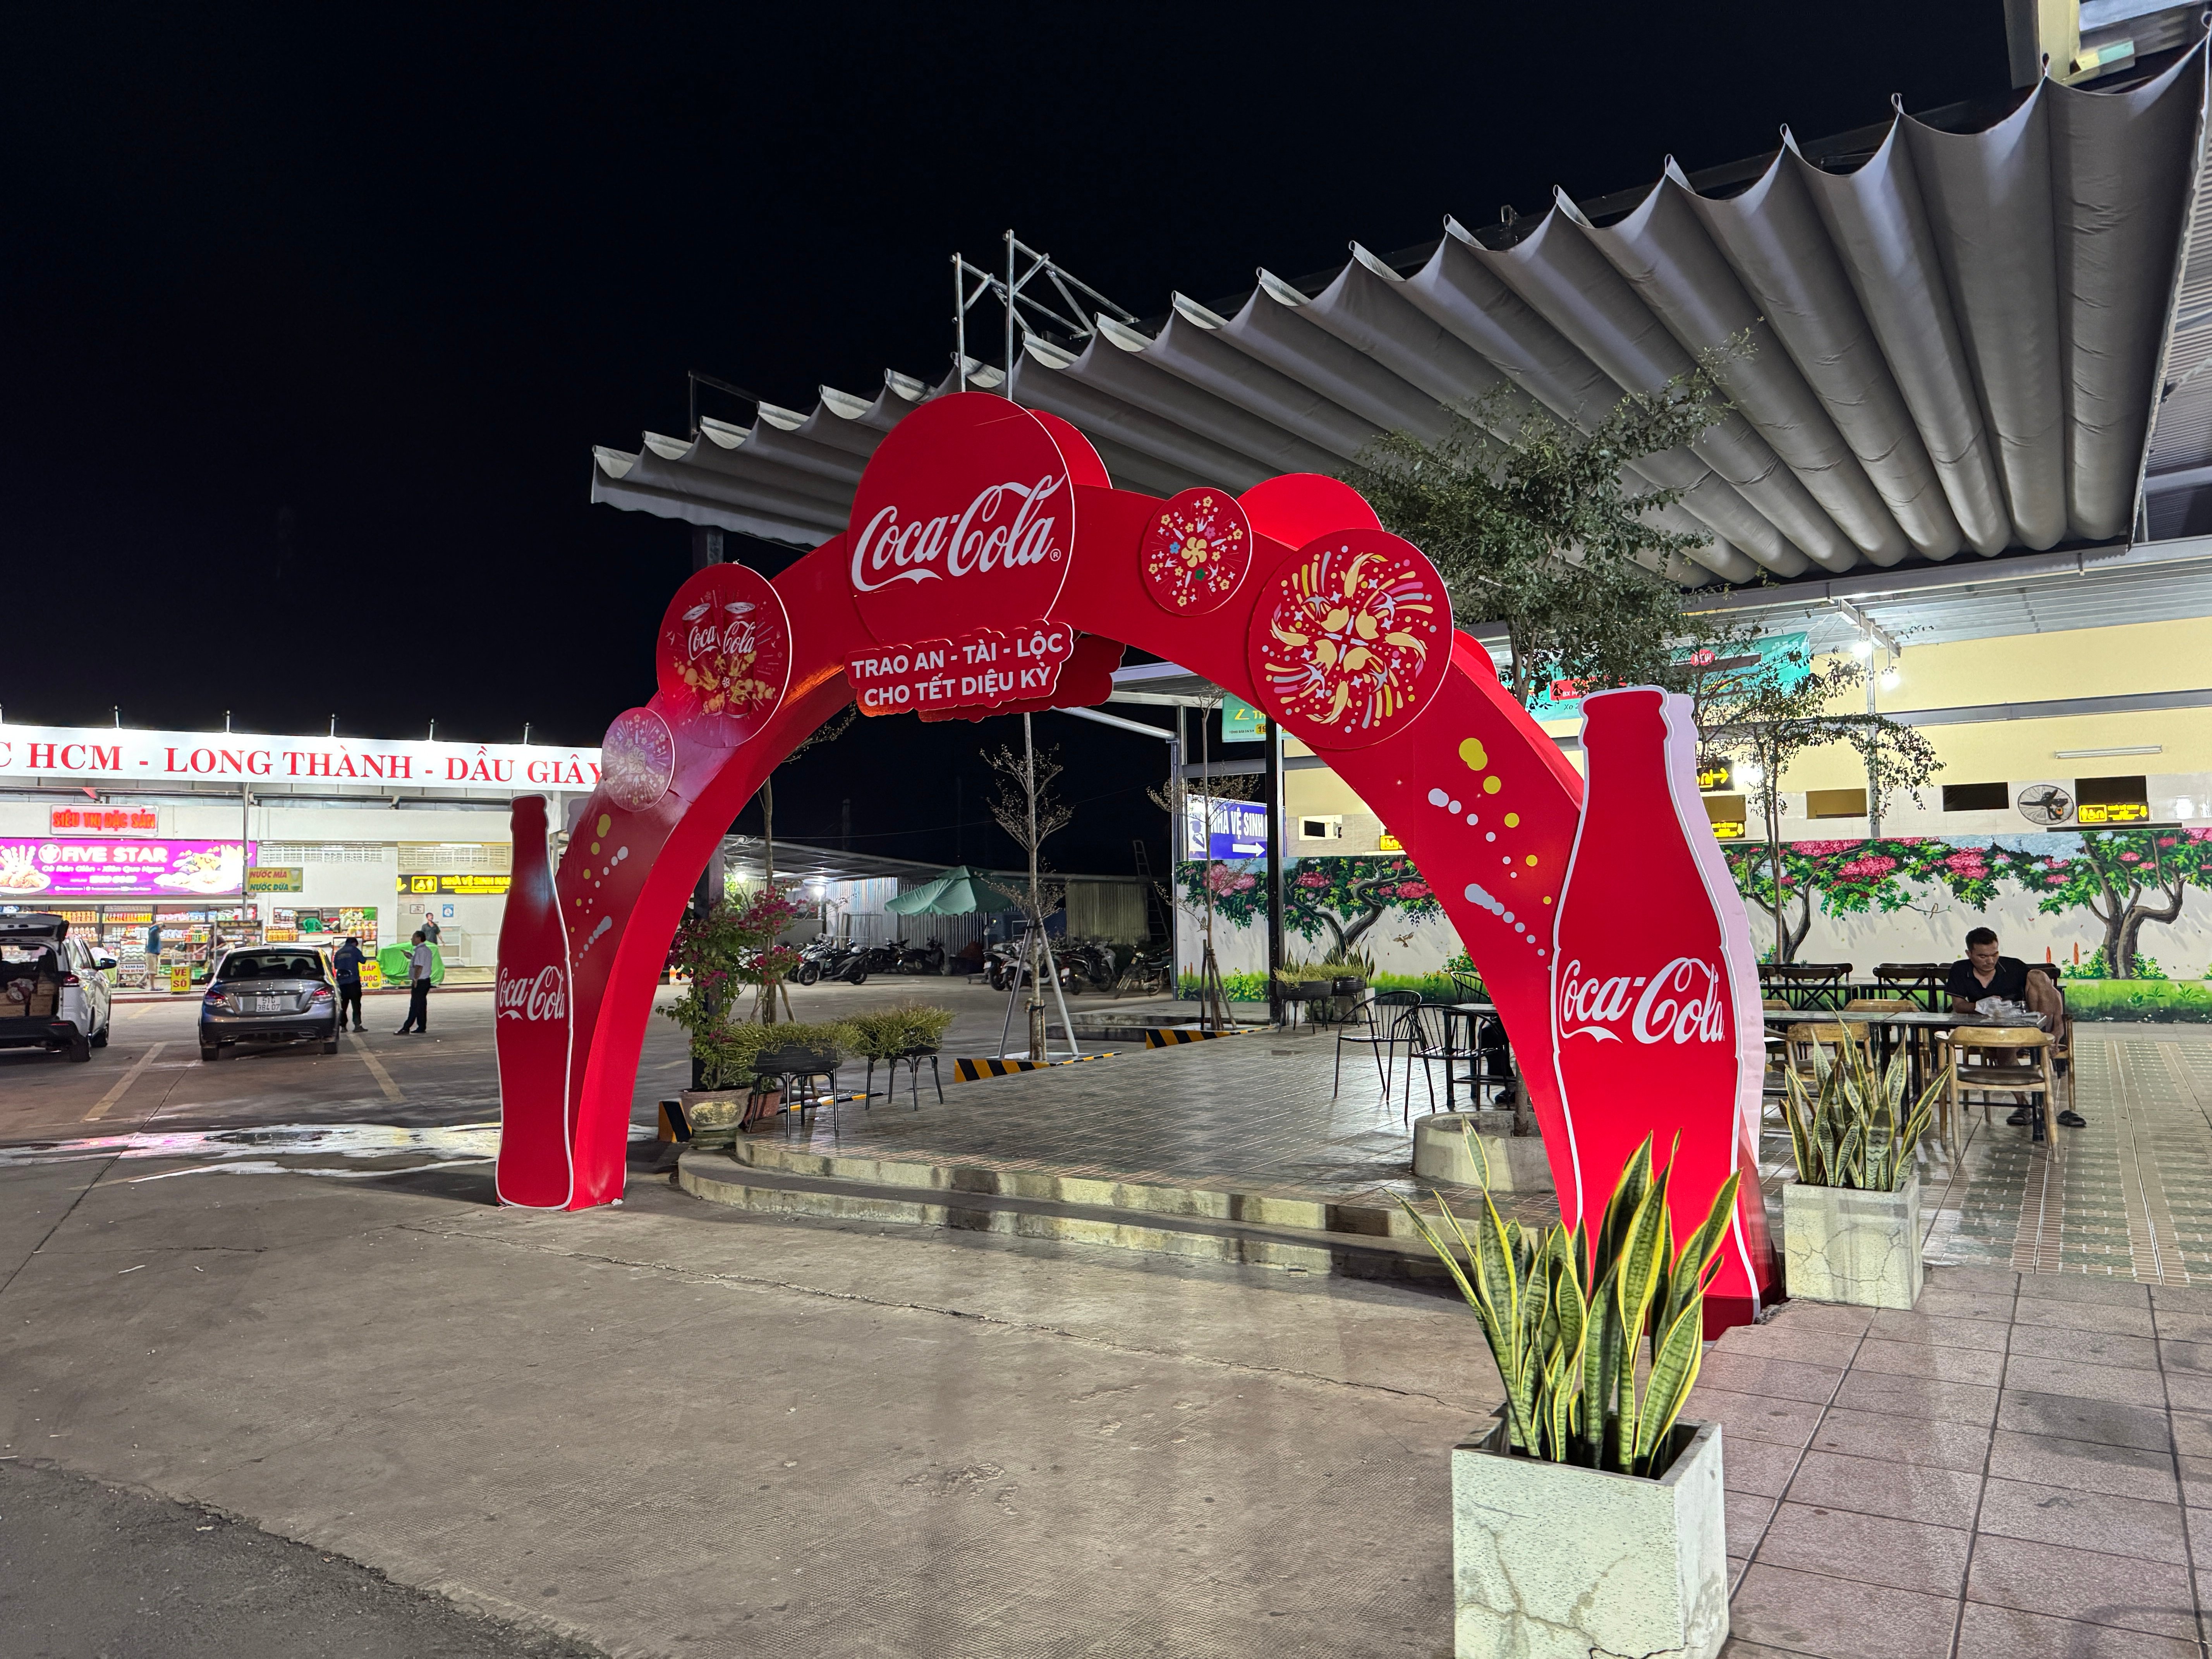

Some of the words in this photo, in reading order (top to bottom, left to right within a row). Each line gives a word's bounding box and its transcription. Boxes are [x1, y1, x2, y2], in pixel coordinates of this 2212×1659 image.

[852, 655, 908, 678] TRAO
[914, 649, 944, 669] AN
[963, 639, 996, 665] TÀI
[1017, 631, 1063, 660] LỘC
[864, 686, 910, 707] CHO
[915, 673, 956, 701] TẾT
[962, 670, 1013, 697] DIỆU
[1021, 662, 1051, 687] KỲ
[26, 743, 124, 771] HCM
[164, 747, 273, 775] LONG
[283, 745, 413, 779] THÀNH
[445, 746, 515, 782] DẦU
[527, 754, 602, 784] GIÂY
[1230, 807, 1242, 840] VỆ
[1243, 812, 1264, 837] SINH
[62, 847, 107, 862] FIVE
[113, 847, 168, 863] STAR
[497, 965, 565, 1021] Coca-Cola
[1559, 957, 1724, 1044] Coca-Cola
